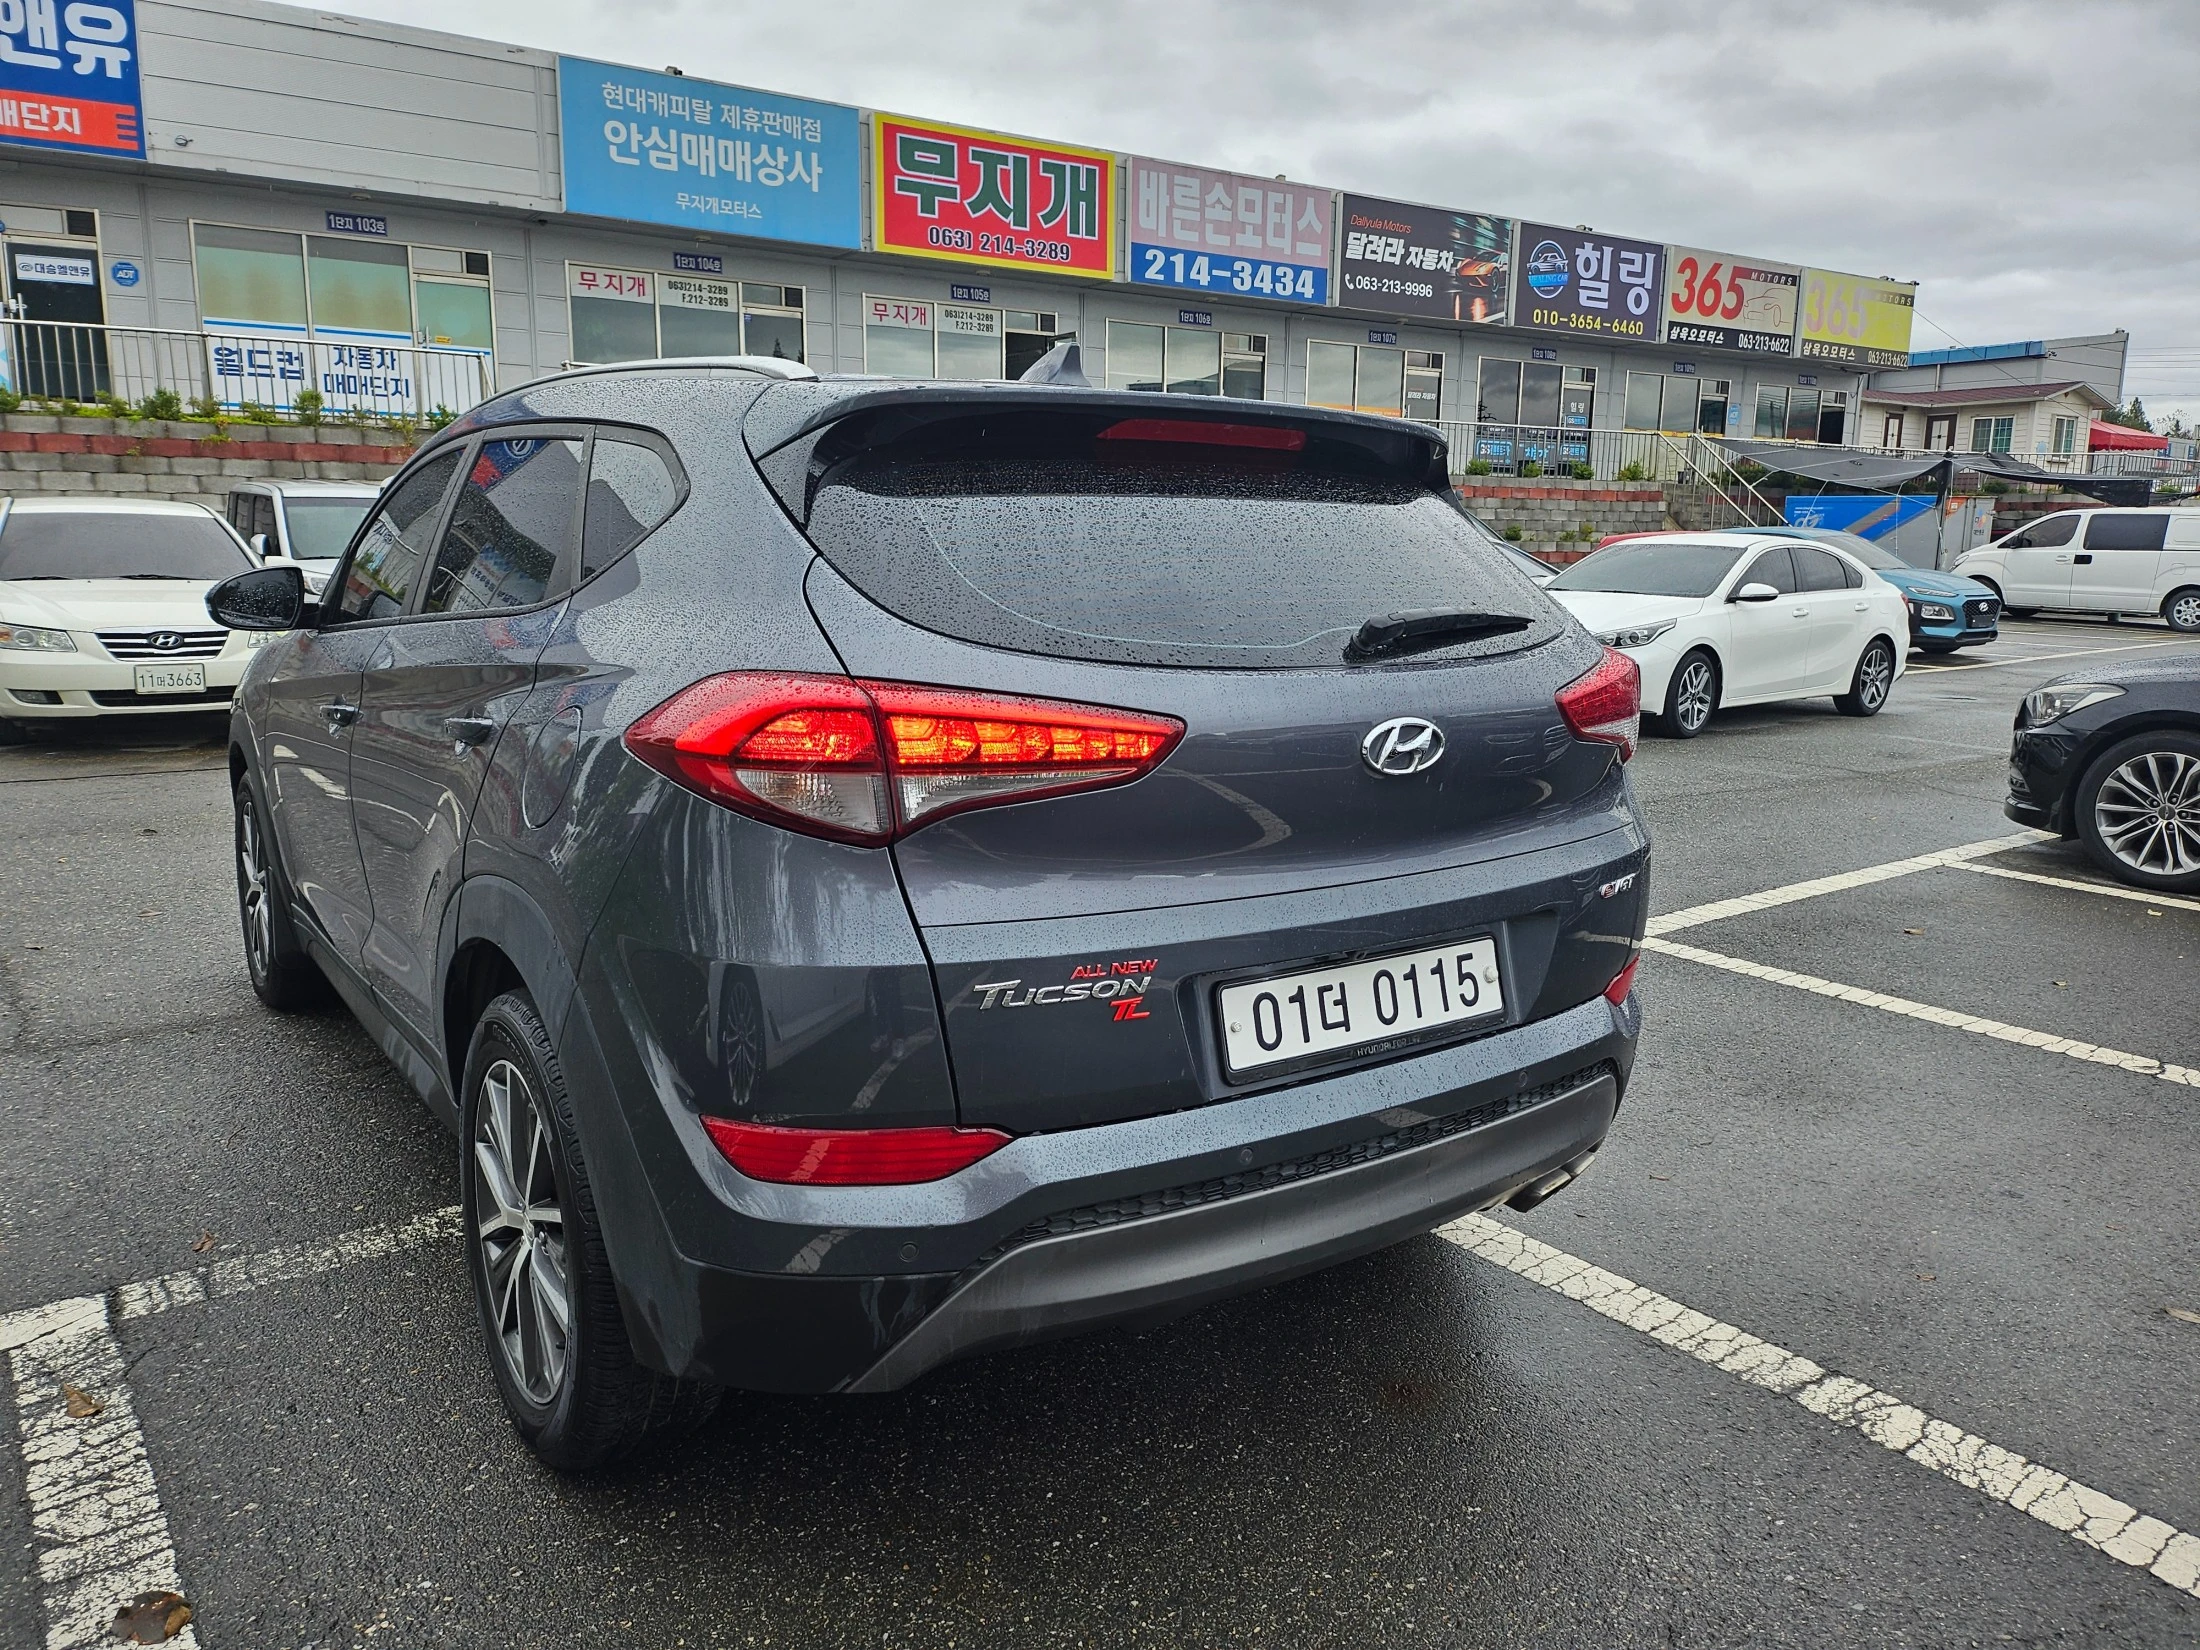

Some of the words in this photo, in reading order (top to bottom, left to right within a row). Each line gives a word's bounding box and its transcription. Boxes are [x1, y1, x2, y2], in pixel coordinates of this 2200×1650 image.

[602, 82, 713, 125] 현대캐피탈
[720, 104, 821, 143] 제휴판매점
[603, 120, 823, 192] 안심매매상사
[894, 133, 1099, 240] 무지개
[675, 192, 762, 219] 무지개모터스
[1138, 170, 1323, 257] 바른손모터스
[328, 213, 353, 230] 1단지
[355, 216, 386, 234] 103호
[1383, 220, 1412, 234] Motors
[928, 226, 973, 250] 063)
[979, 233, 1071, 262] 214-3289
[1345, 231, 1405, 266] 달려라
[1405, 246, 1454, 272] 자동차
[675, 254, 695, 269] 1단지
[696, 256, 722, 272] 104호
[1144, 249, 1315, 299] 214-3434
[578, 271, 646, 297] 무지개
[1355, 275, 1433, 298] 063-213-9996
[1575, 242, 1656, 316] 힐링
[1671, 256, 1748, 320] 365
[1750, 271, 1793, 286] MOTORS
[682, 293, 729, 307] F.212-3289
[952, 285, 968, 298] 1단지
[970, 287, 990, 301] 105호
[872, 302, 927, 325] 무지개
[1805, 279, 1867, 338] 365
[955, 321, 994, 333] F.212-3289
[1533, 309, 1643, 335] 010-3654-6460
[1670, 325, 1725, 345] 삼육오모터스
[1738, 332, 1790, 353] 063-213-6622
[1803, 341, 1856, 360] 삼육오모터스
[214, 346, 305, 381] 월드컵
[333, 346, 397, 371] 자동차
[1867, 351, 1909, 368] 063-213-6622
[323, 373, 410, 399] 매매단지
[1570, 401, 1585, 413] 힐링
[1070, 963, 1108, 981] ALL
[1110, 958, 1159, 977] NEW
[1109, 996, 1150, 1022] TL
[1252, 982, 1351, 1052] 01더
[1372, 952, 1480, 1026] 0115
